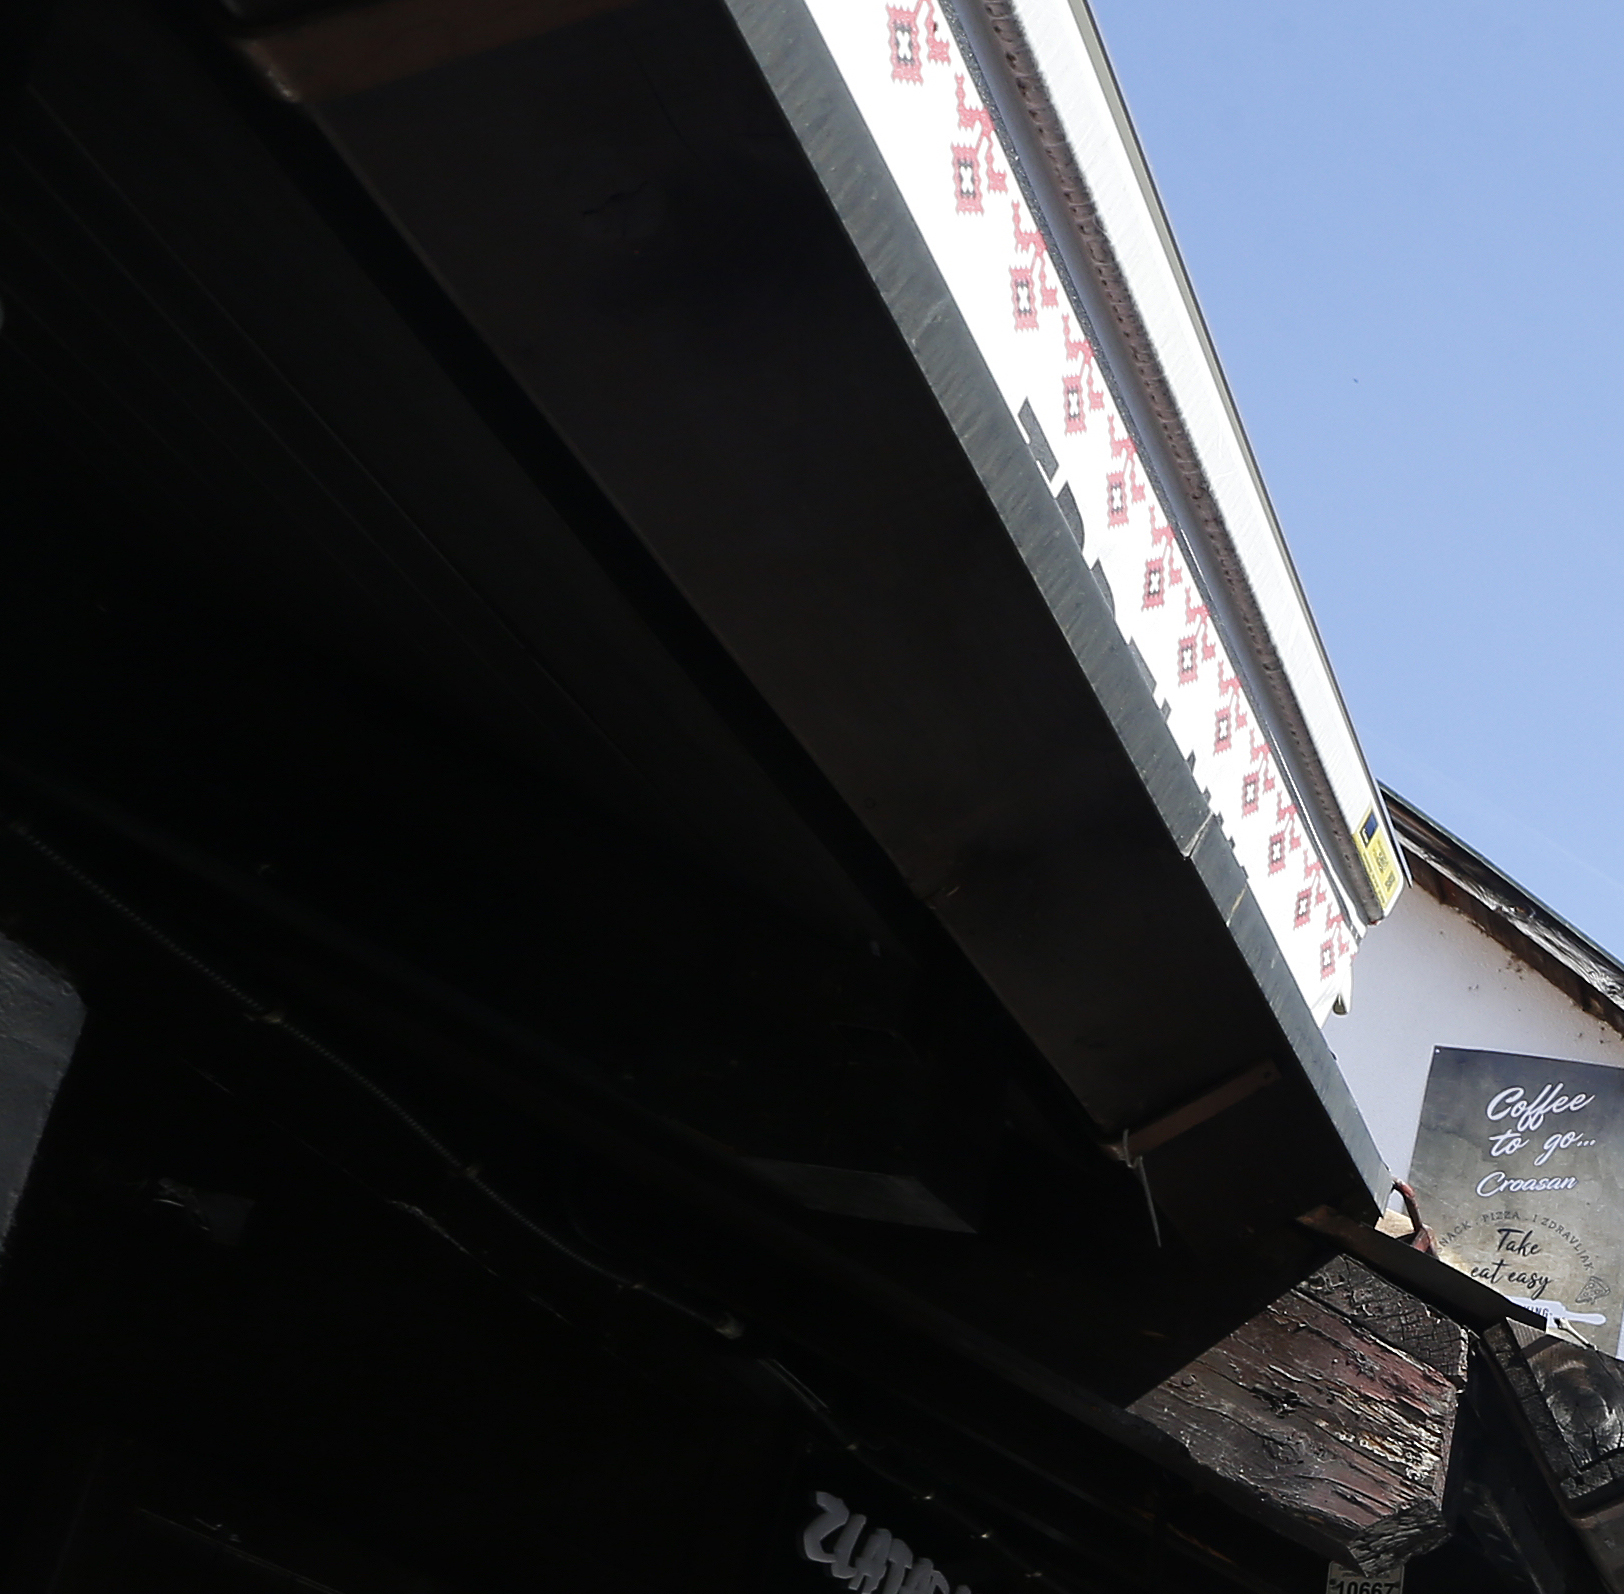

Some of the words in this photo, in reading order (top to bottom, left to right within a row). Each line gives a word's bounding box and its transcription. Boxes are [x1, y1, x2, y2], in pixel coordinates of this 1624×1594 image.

[1486, 1082, 1596, 1132] Coffee
[1488, 1129, 1530, 1157] to
[1475, 1171, 1579, 1198] Croasan
[1482, 1211, 1521, 1222] PIZZA
[1497, 1228, 1542, 1257] Take
[1470, 1259, 1509, 1285] eat
[1508, 1271, 1553, 1301] easy
